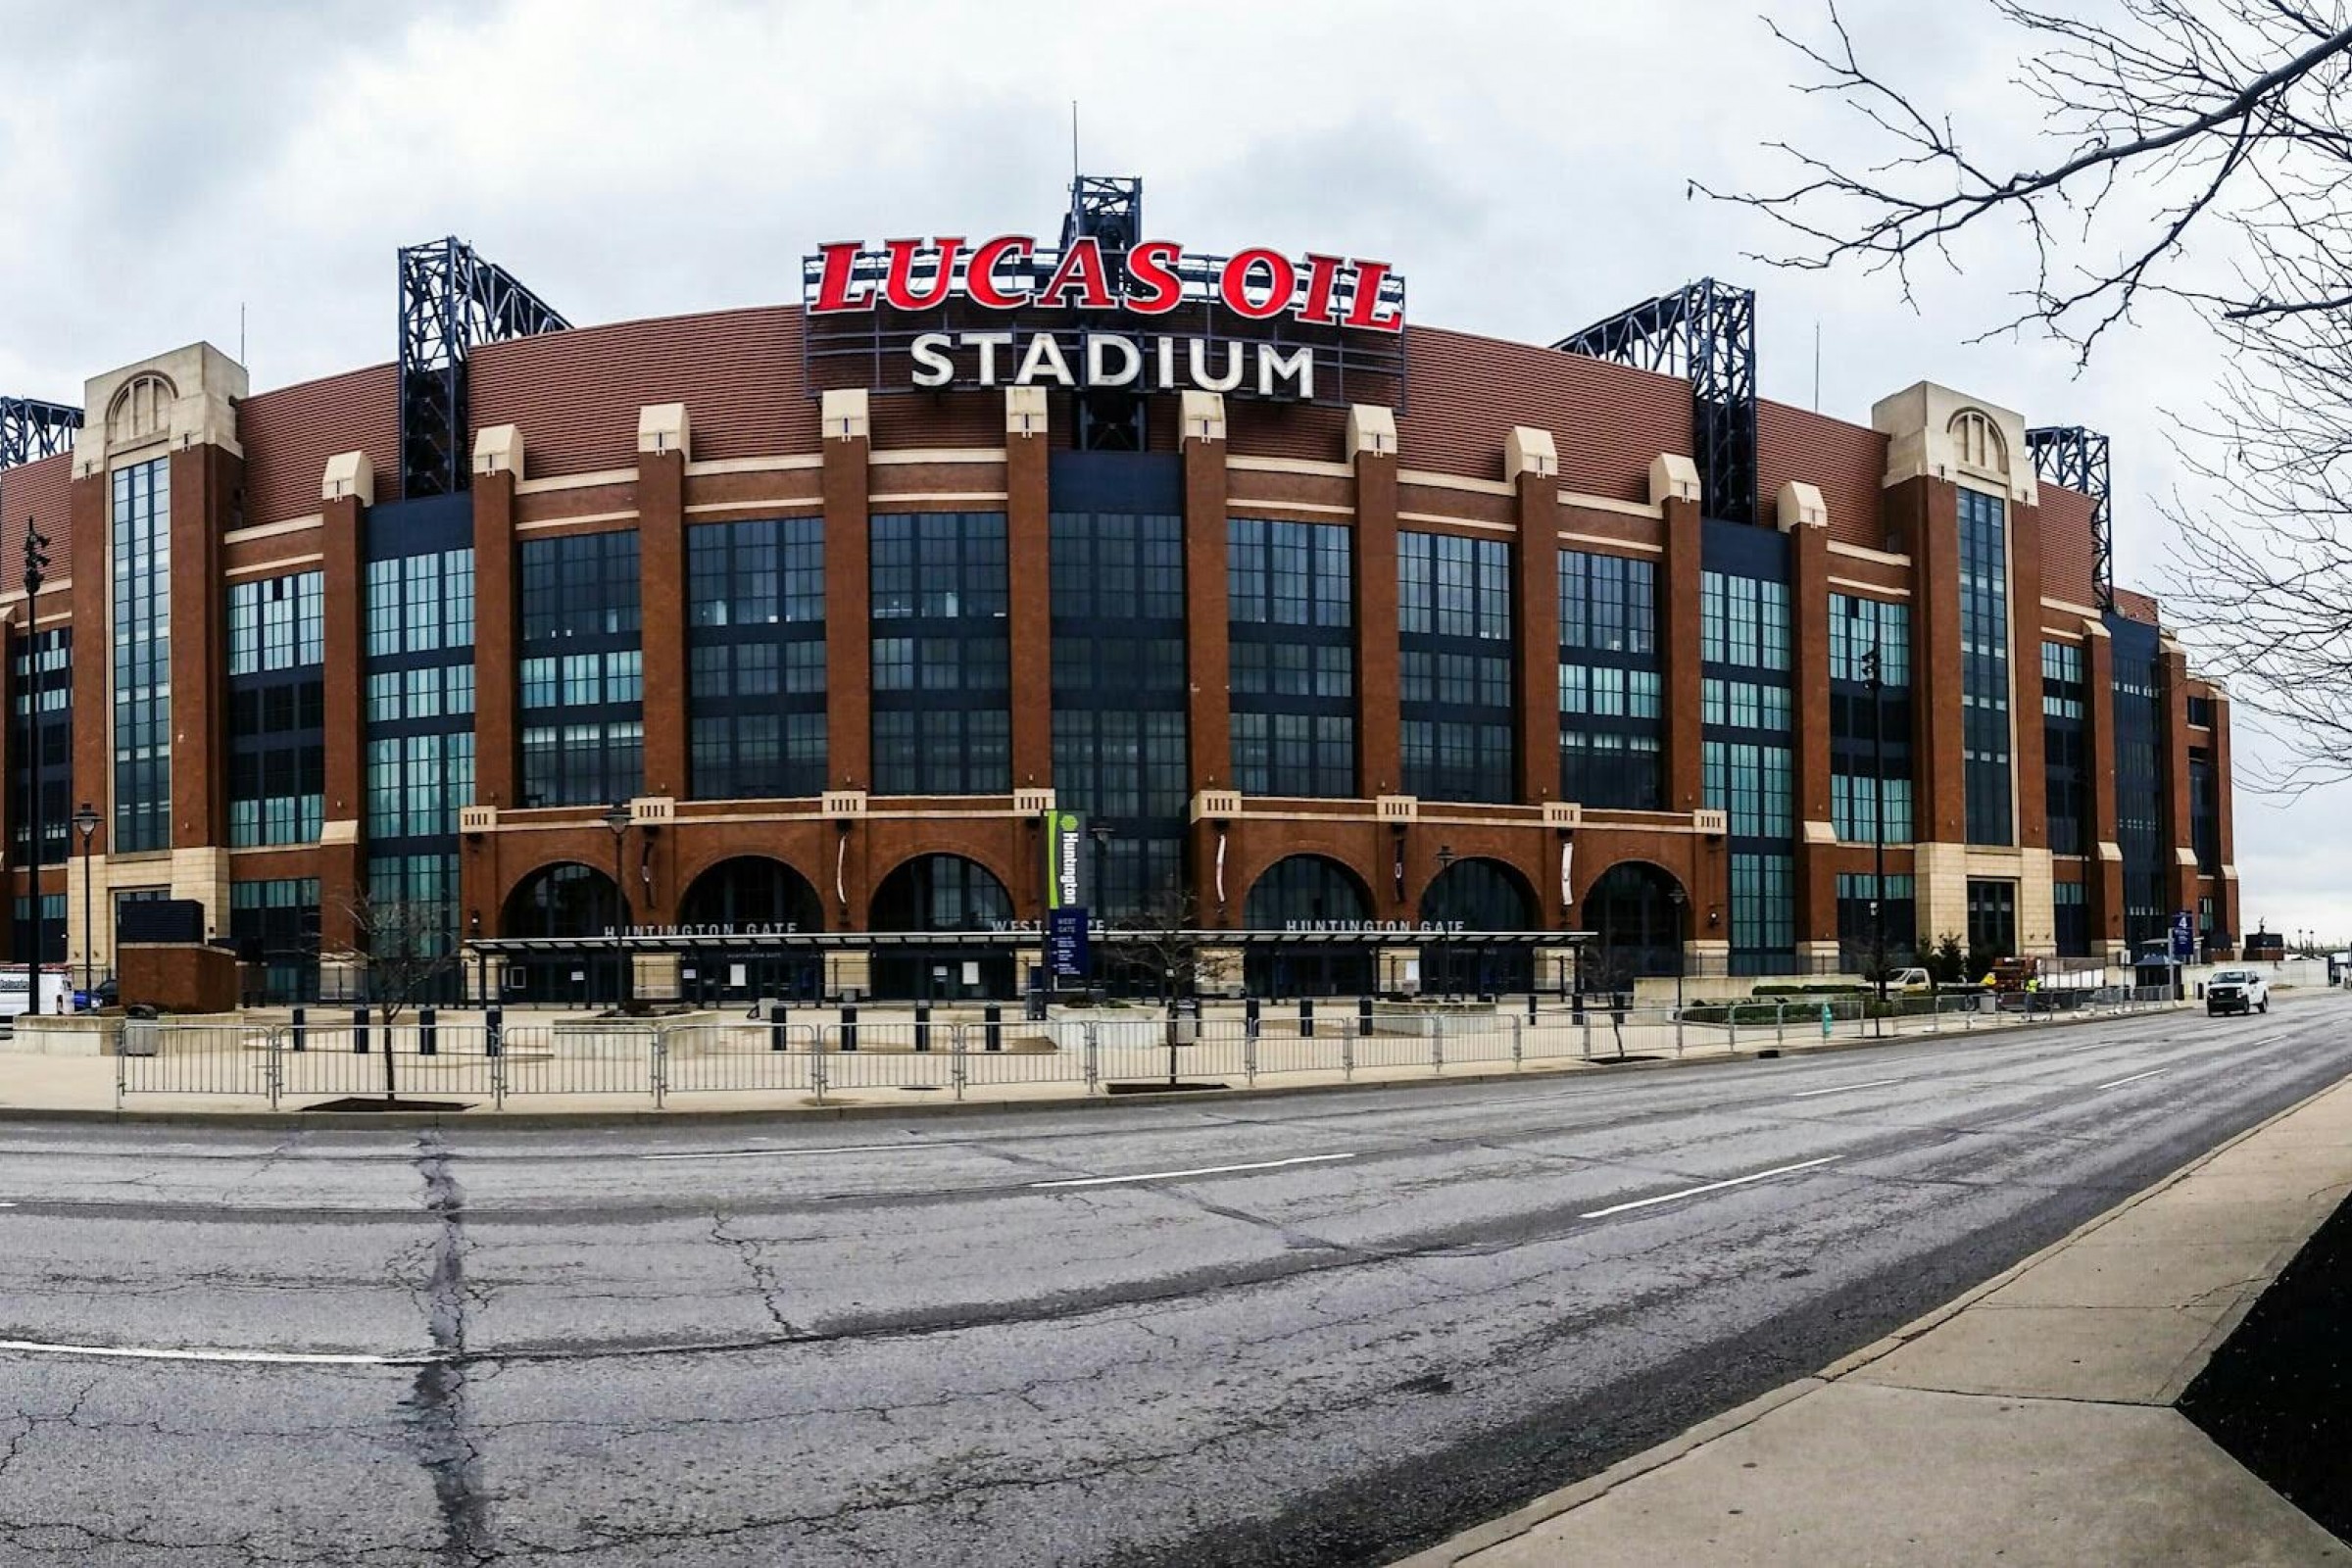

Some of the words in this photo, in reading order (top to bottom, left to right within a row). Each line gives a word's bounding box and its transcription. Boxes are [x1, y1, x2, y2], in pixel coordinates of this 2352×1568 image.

[807, 234, 1184, 315] LUCAS
[1219, 247, 1405, 334] OIL
[909, 331, 1314, 399] STADIUM
[1059, 832, 1079, 905] Huntington
[746, 923, 798, 935] GATE
[1286, 920, 1411, 931] HUNTINGTON
